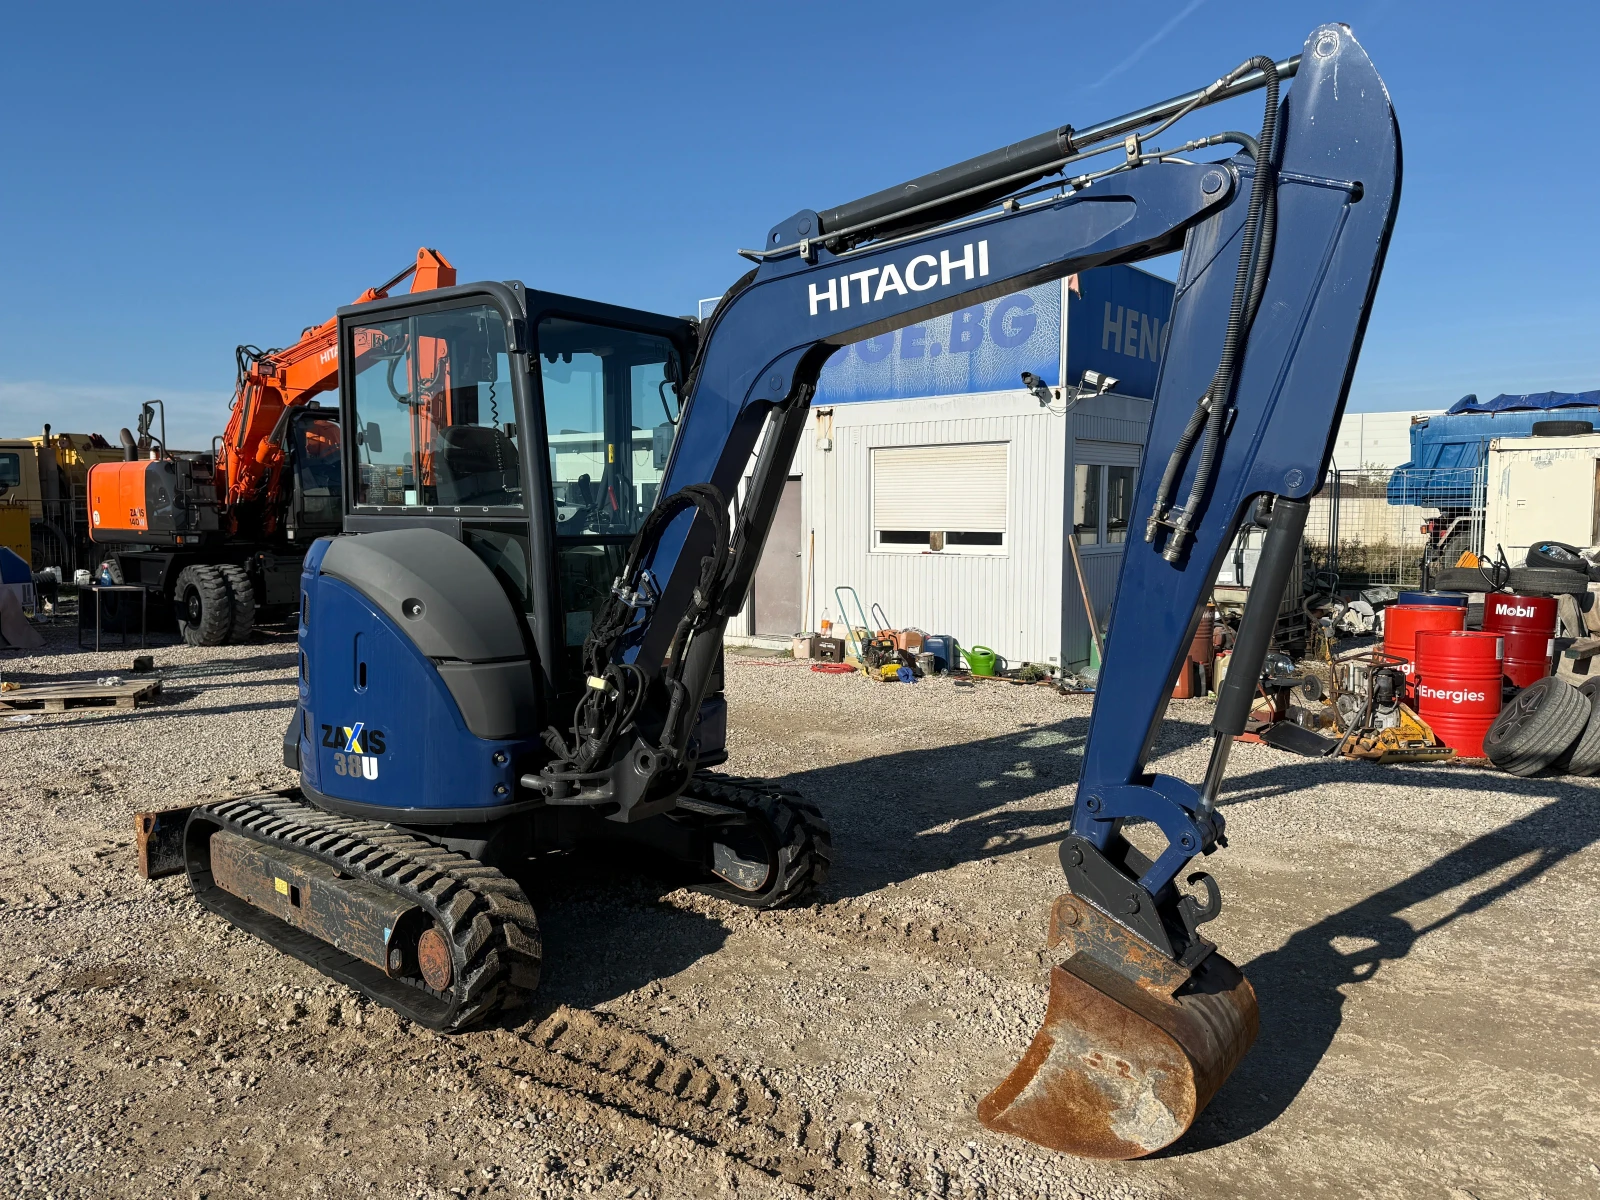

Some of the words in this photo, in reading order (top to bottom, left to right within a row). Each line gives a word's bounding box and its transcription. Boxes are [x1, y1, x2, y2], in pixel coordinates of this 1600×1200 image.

[808, 239, 989, 316] HITACHI
[1495, 603, 1535, 618] Mobil
[321, 721, 387, 755] ZAXIS
[333, 752, 379, 781] 38U
